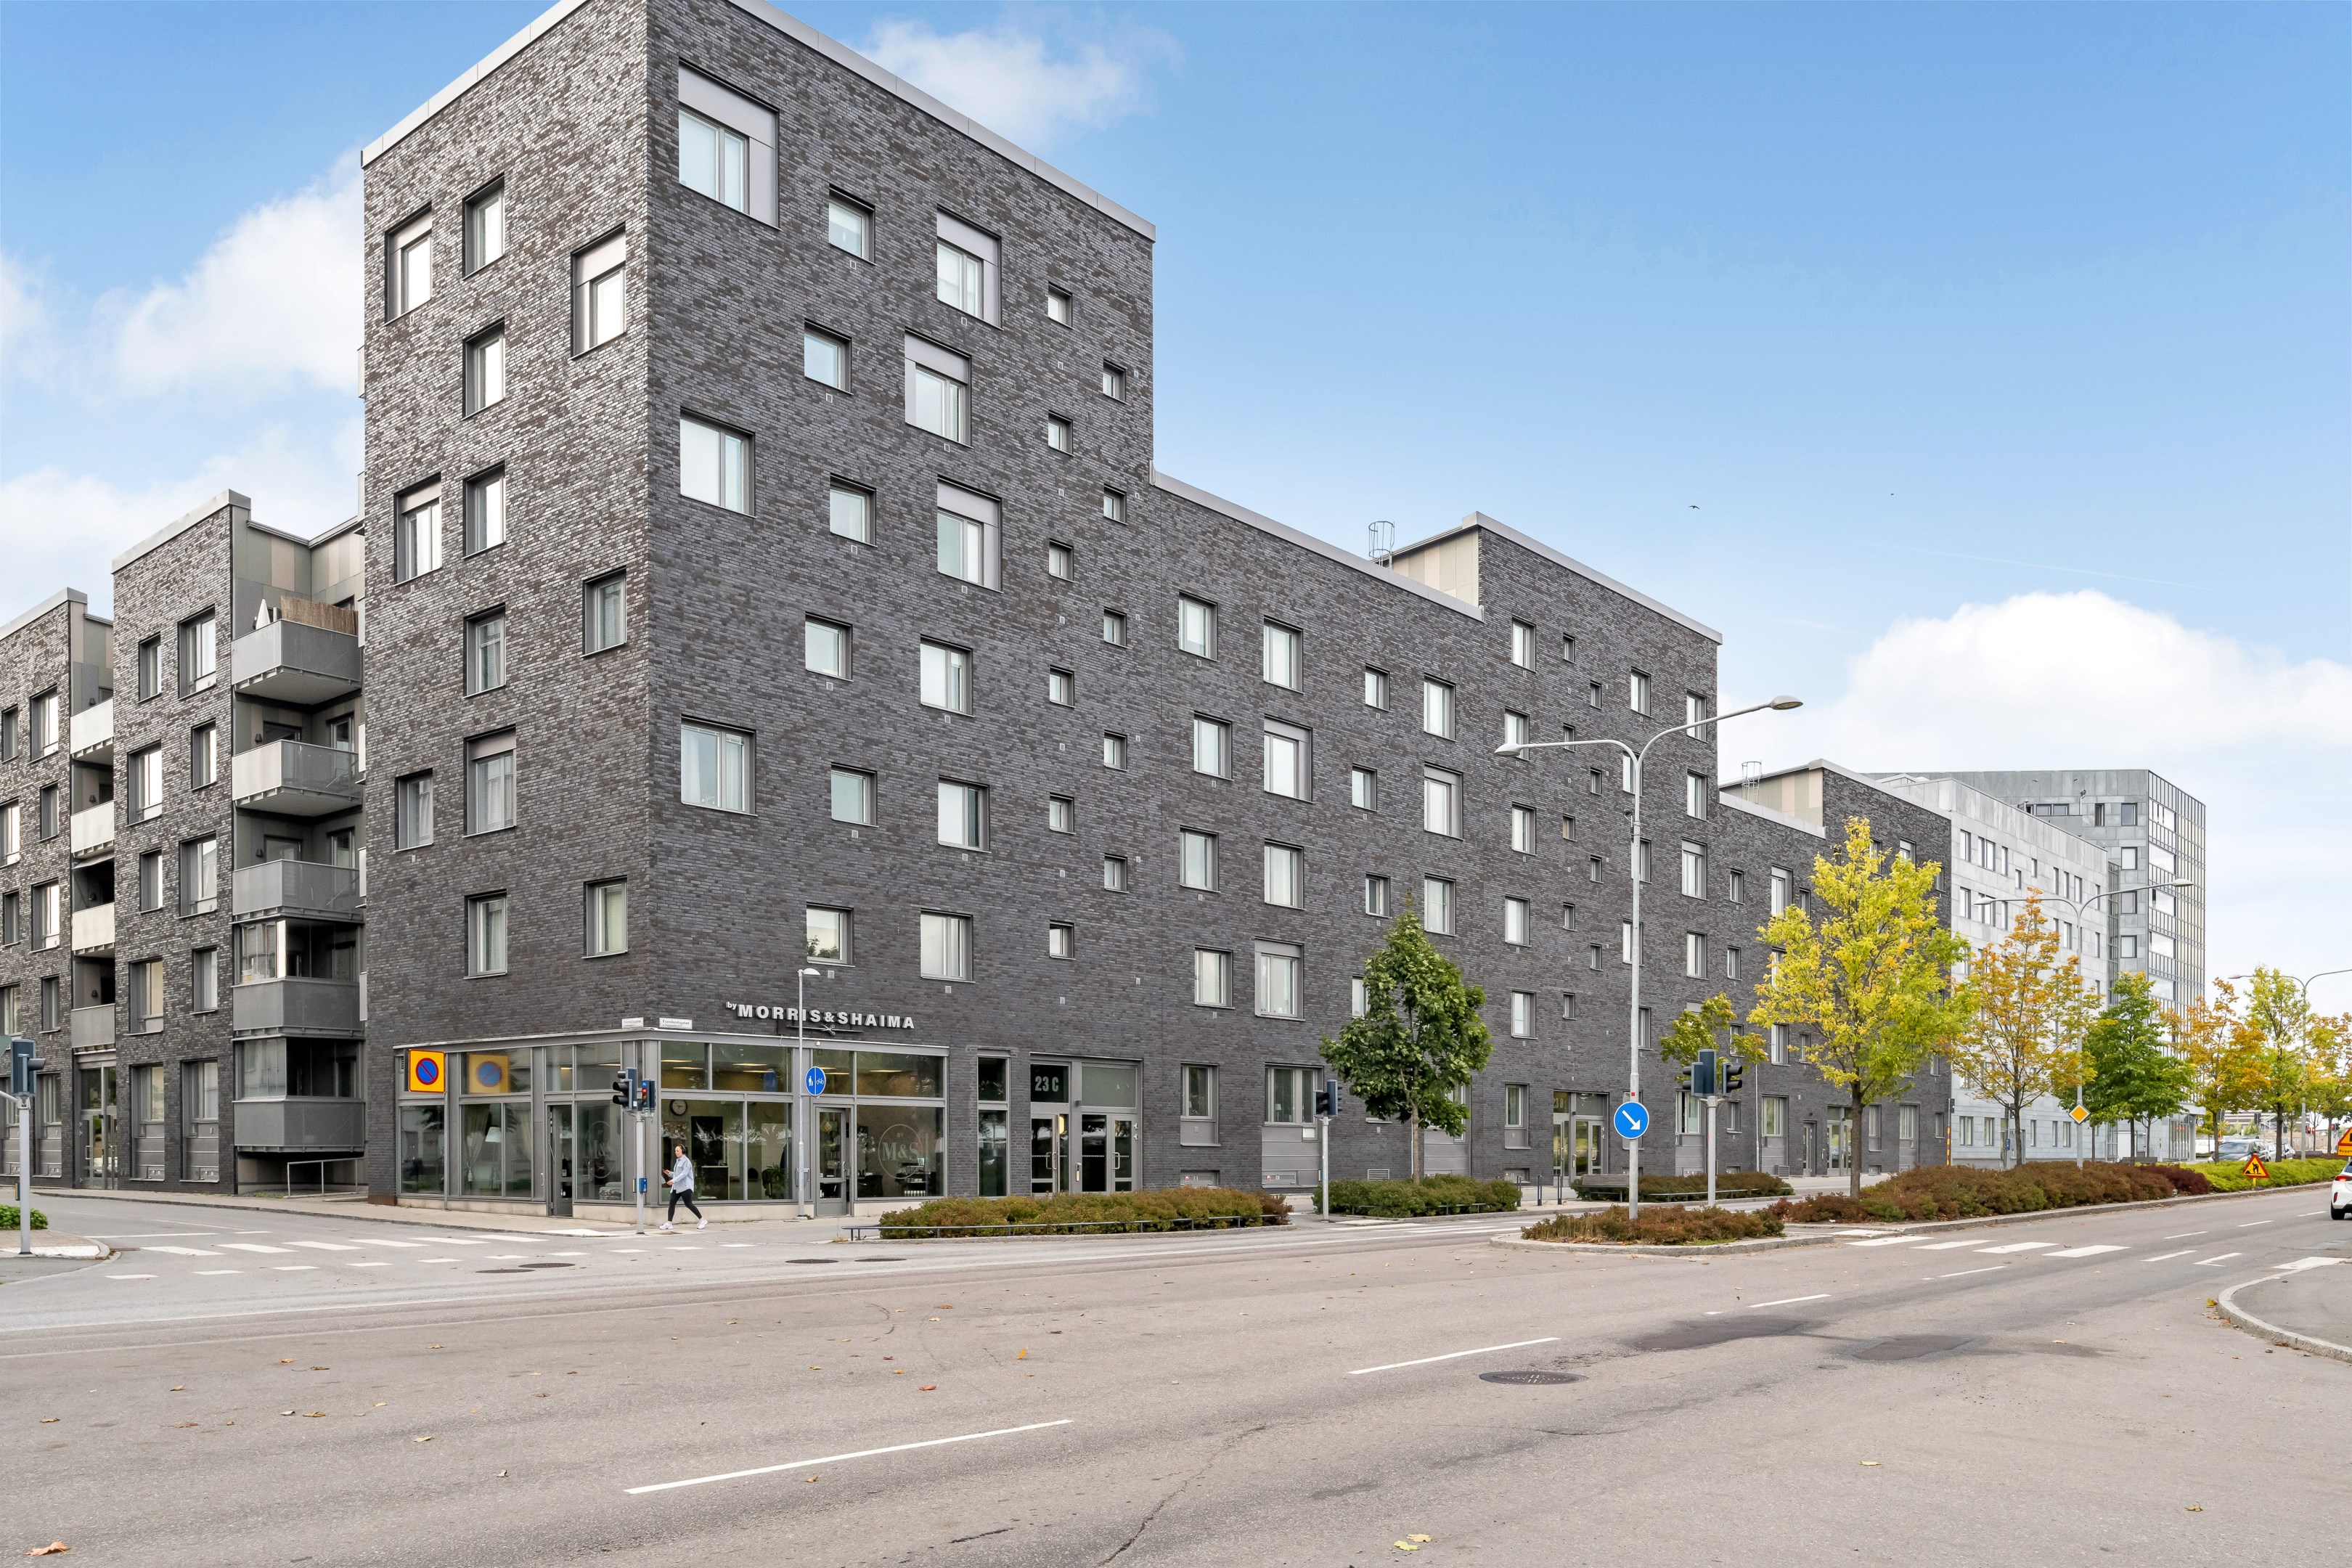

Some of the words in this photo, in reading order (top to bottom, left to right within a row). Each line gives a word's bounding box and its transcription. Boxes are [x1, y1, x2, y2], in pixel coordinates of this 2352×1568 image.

[738, 1005, 914, 1029] MORRIS&SHAIMA
[1035, 1076, 1049, 1091] 23
[1052, 1077, 1059, 1092] C
[882, 1142, 918, 1161] M&S
